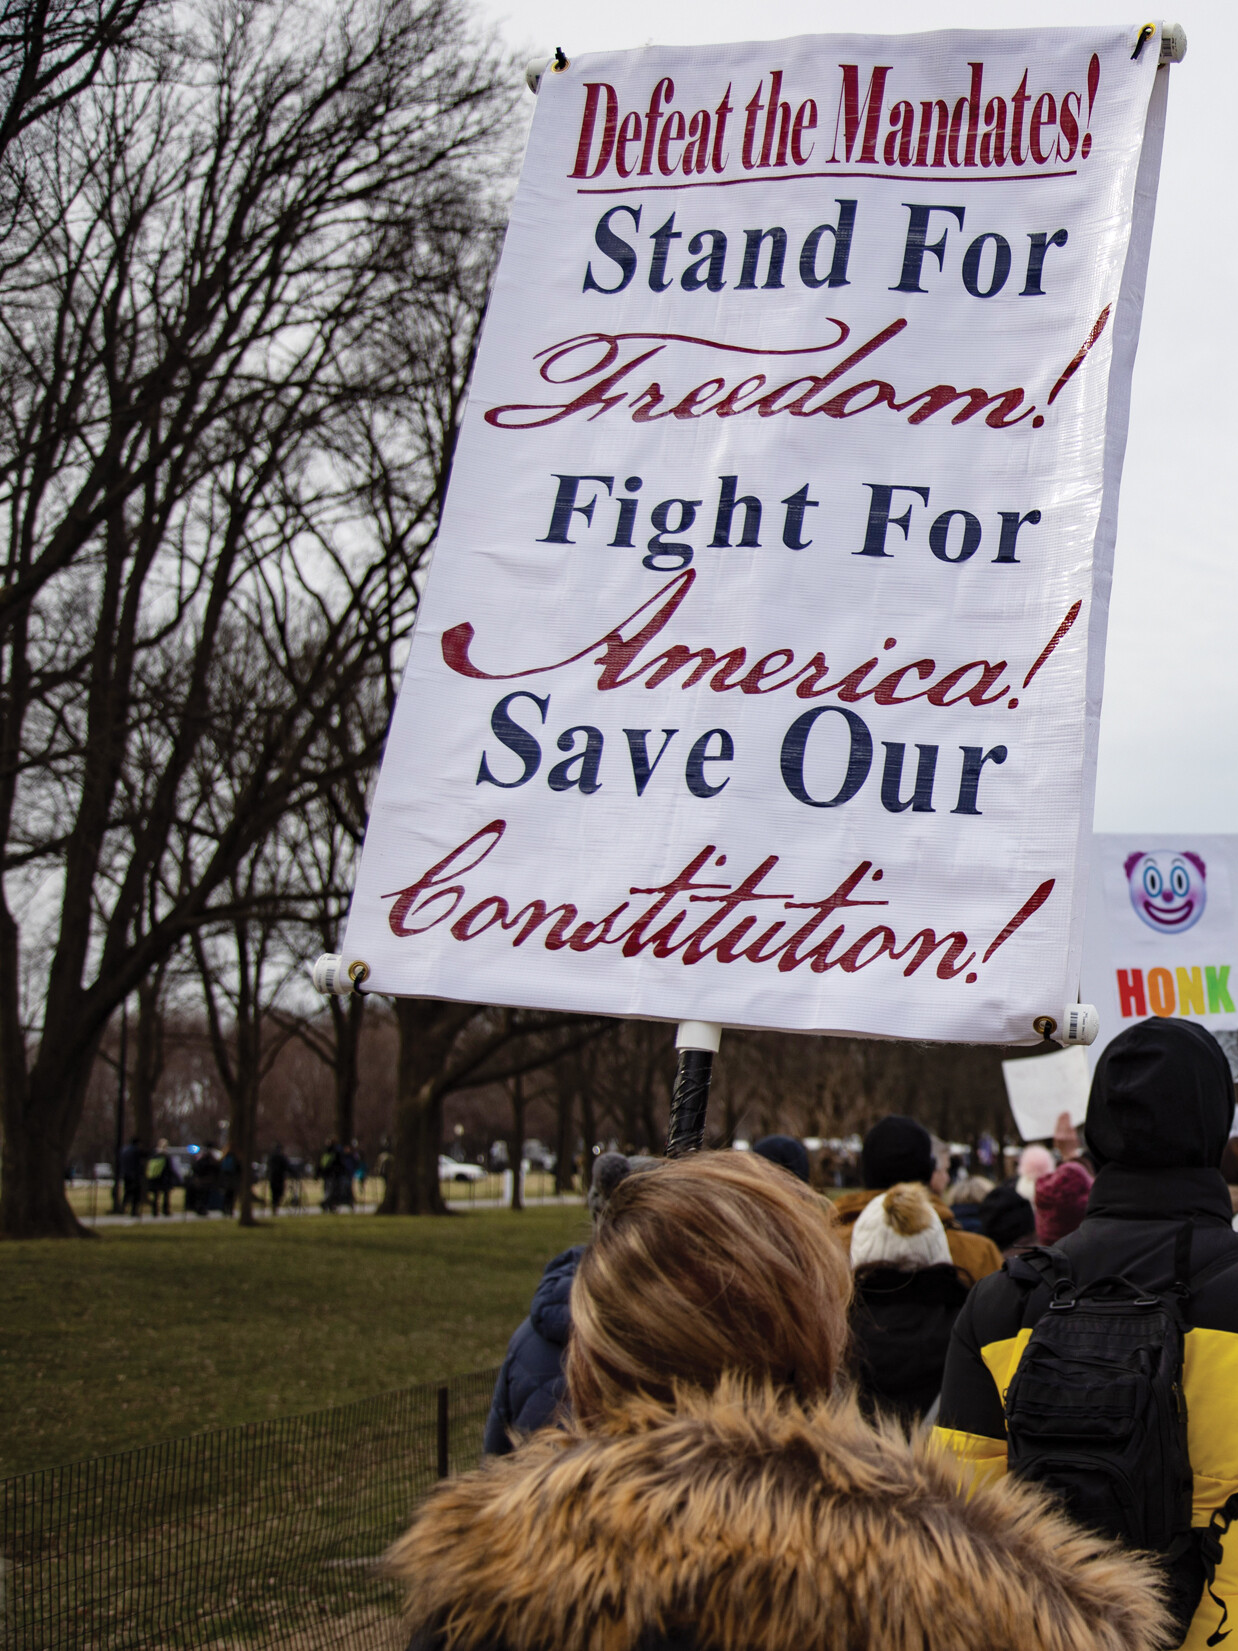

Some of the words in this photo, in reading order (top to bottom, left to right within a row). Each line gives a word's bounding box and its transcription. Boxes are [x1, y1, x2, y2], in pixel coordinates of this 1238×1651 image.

[566, 76, 733, 180] Defeat
[741, 69, 818, 171] the
[825, 52, 1101, 169] Mandates!
[582, 198, 858, 295] Stand
[887, 202, 1069, 299] For
[483, 302, 1113, 430] Freedom!
[535, 473, 820, 572] Fight
[850, 482, 1042, 564] For
[440, 567, 1083, 710] America!
[475, 690, 735, 799] Save
[779, 705, 1008, 816] Our
[380, 818, 1056, 984] Constitution!
[1116, 965, 1236, 1019] HONK
